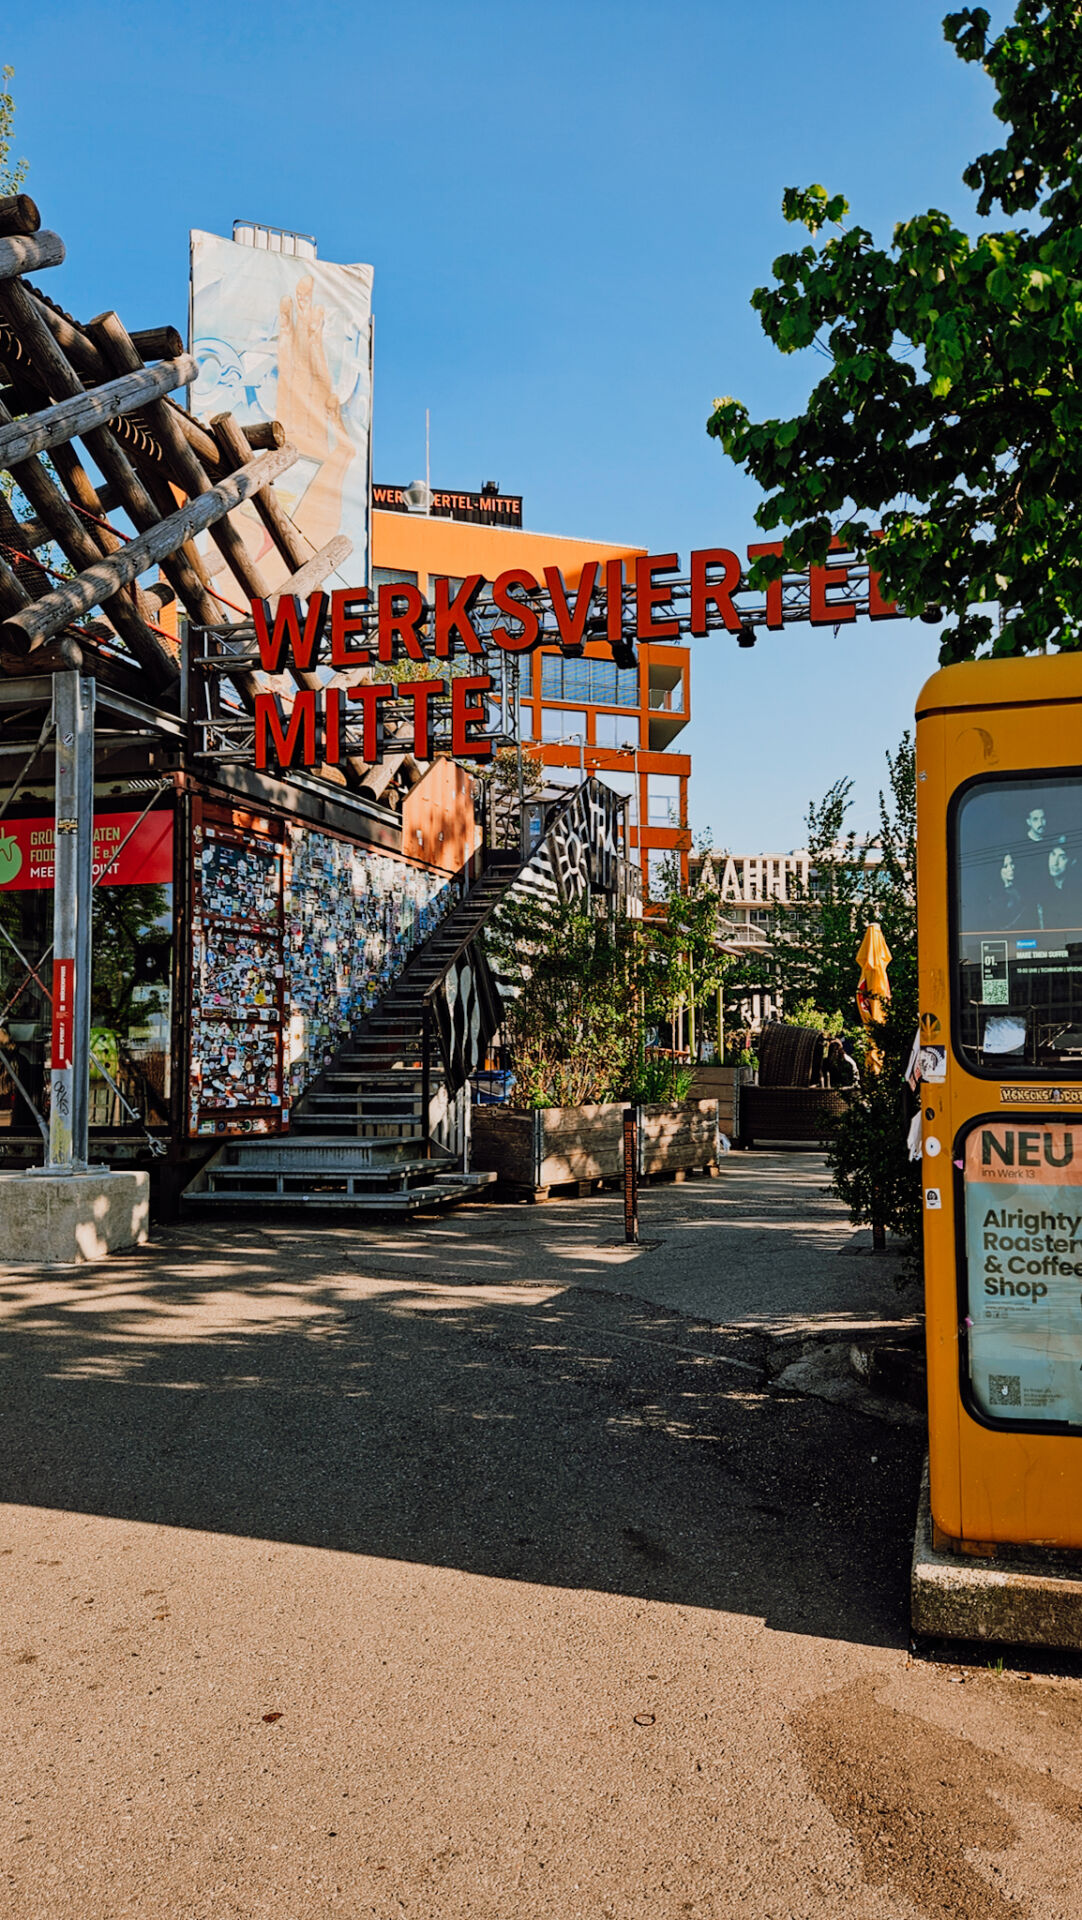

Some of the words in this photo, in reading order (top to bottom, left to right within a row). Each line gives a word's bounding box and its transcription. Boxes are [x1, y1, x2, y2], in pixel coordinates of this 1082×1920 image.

[373, 488, 520, 513] WERERTEL-MITTE
[254, 675, 496, 770] MITTE
[92, 862, 120, 876] OINT
[984, 955, 998, 966] 01.
[981, 1130, 1074, 1168] NEU
[981, 1168, 996, 1177] im
[998, 1168, 1024, 1178] Werk
[1026, 1169, 1036, 1179] 13
[983, 1208, 1082, 1238] Alrighty
[984, 1255, 1004, 1274] &
[984, 1277, 1048, 1304] Shop
